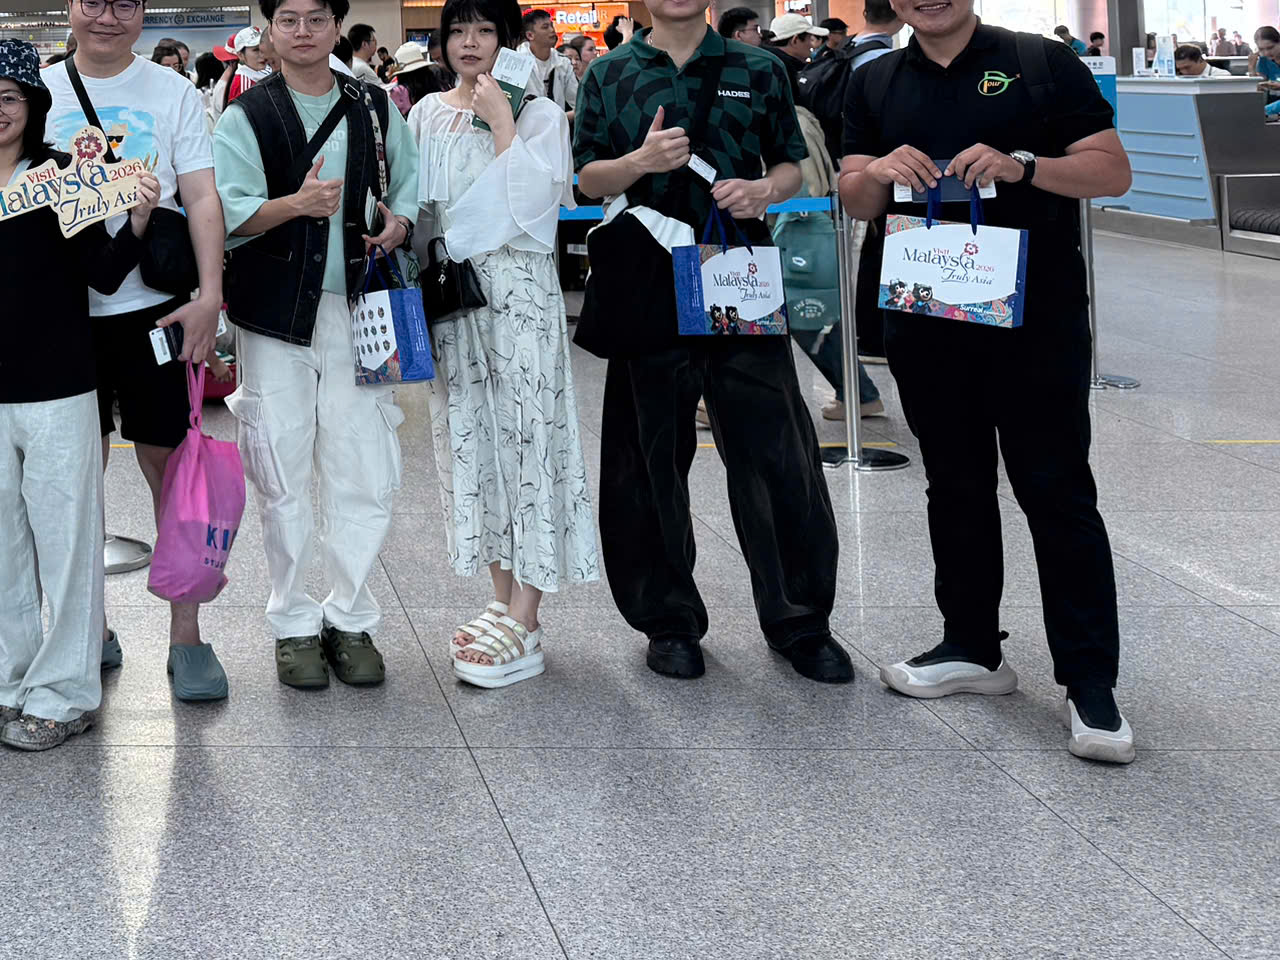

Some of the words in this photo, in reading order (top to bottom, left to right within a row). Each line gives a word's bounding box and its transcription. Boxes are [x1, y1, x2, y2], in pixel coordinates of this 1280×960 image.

[187, 14, 225, 24] EXCHANGE
[555, 9, 597, 25] Retail
[717, 90, 750, 98] HADES
[26, 167, 57, 184] Visit
[109, 161, 142, 182] 2026
[60, 197, 110, 226] Truly
[114, 186, 138, 208] Asi
[903, 247, 975, 269] Malaysia
[941, 267, 970, 283] Truly
[972, 275, 994, 285] Asia
[960, 303, 984, 313] Surreal
